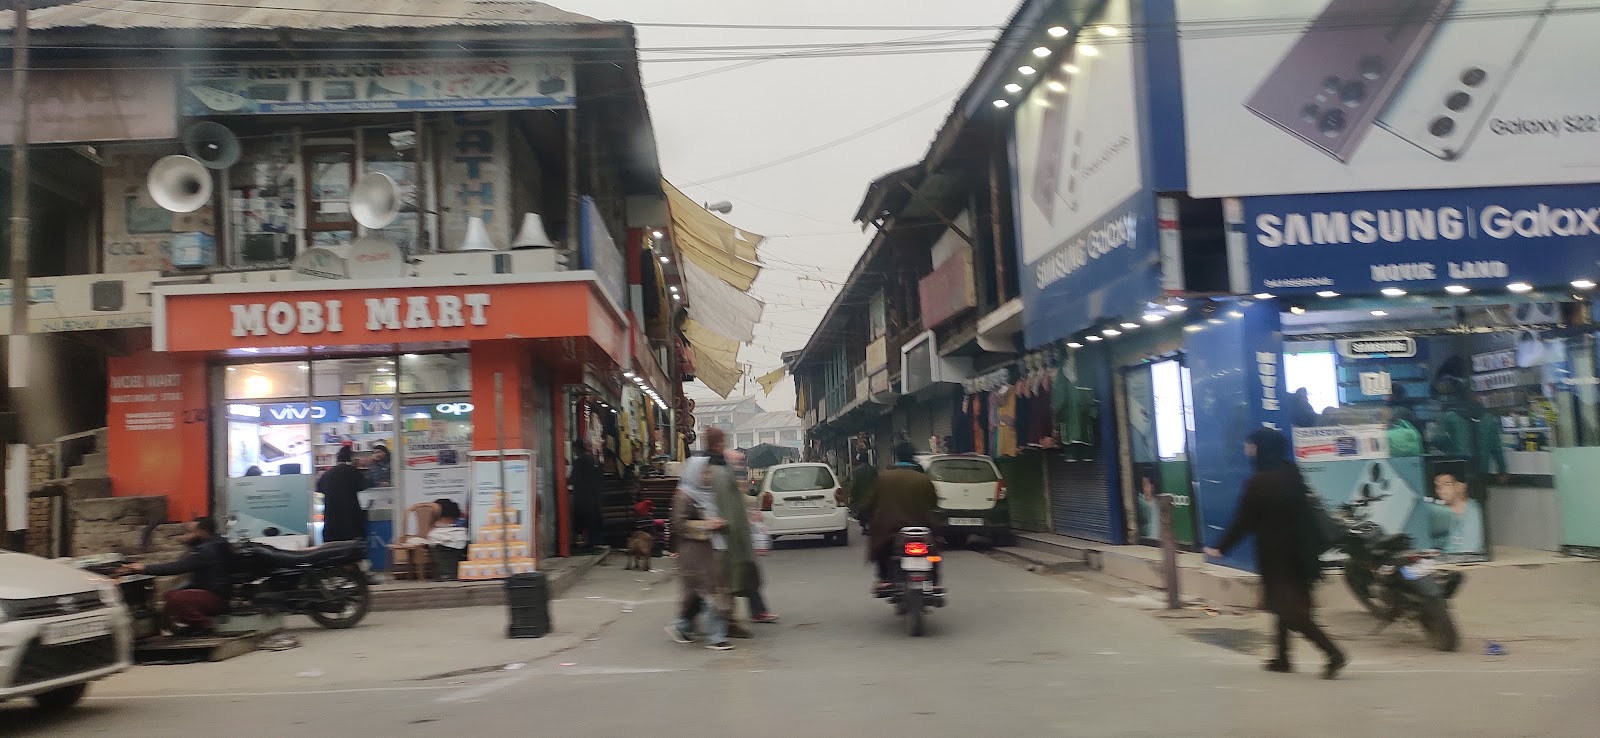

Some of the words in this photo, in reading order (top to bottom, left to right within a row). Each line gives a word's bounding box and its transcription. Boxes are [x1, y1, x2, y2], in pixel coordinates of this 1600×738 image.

[304, 62, 384, 78] MAJOR
[1489, 117, 1560, 138] Galaxy
[1256, 206, 1465, 248] SAMSUNG
[1036, 238, 1088, 290] SAMSUNG
[1447, 259, 1509, 279] LAND
[230, 300, 344, 337] MOBI
[365, 293, 491, 331] MART
[1351, 341, 1407, 352] SAMSUNG
[270, 404, 327, 420] vivo
[361, 398, 396, 411] viv
